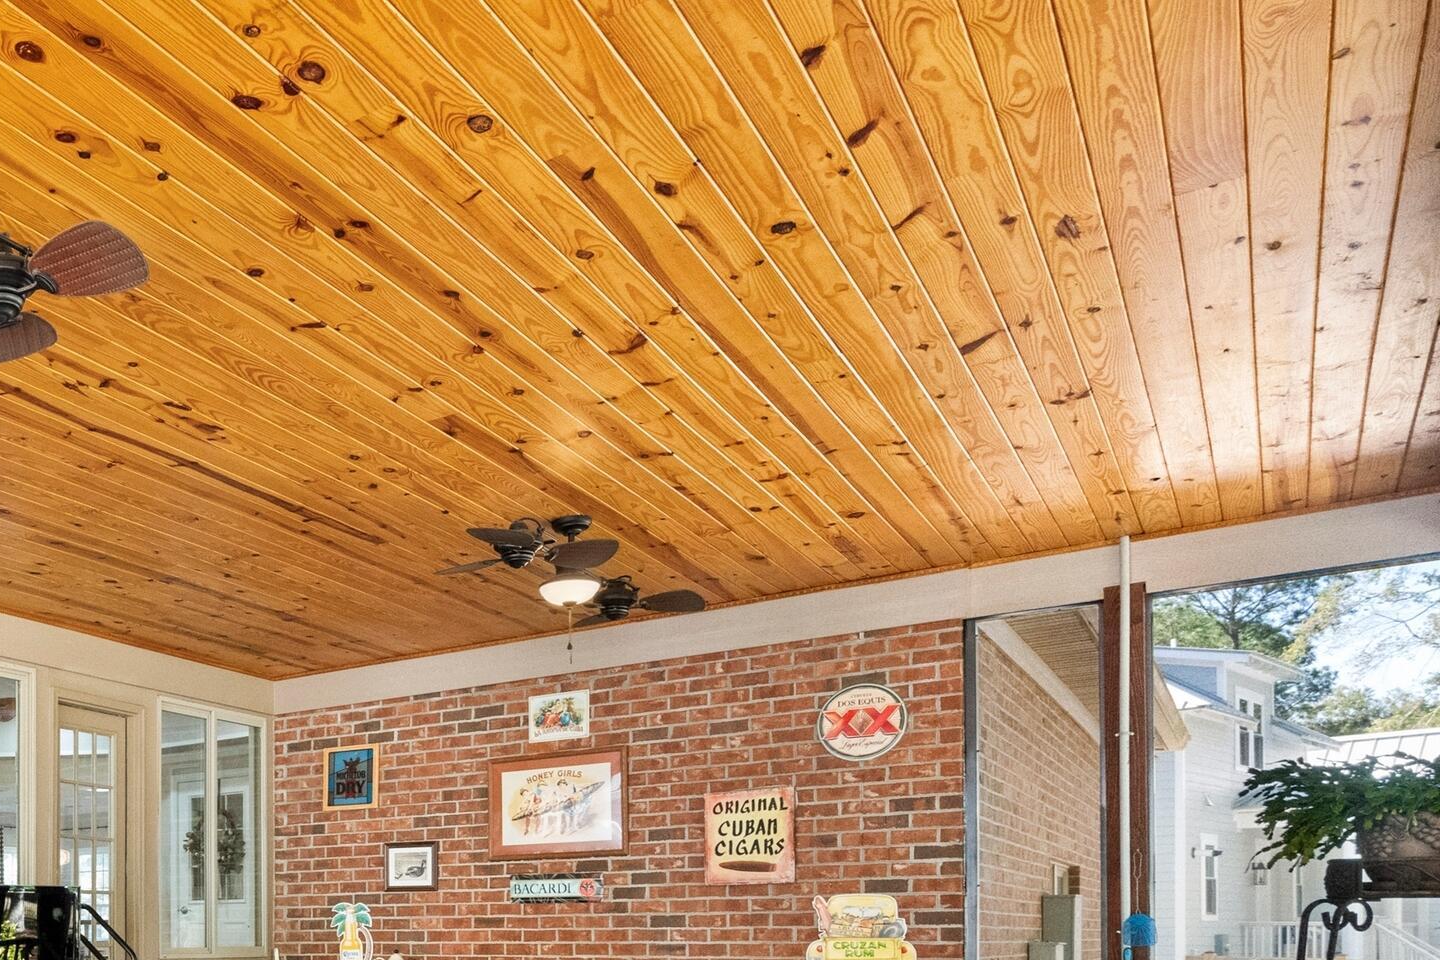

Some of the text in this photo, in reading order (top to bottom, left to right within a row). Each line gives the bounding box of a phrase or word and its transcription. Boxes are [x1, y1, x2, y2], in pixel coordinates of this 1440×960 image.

[837, 697, 886, 708] DOS EQUIS
[823, 704, 901, 740] XX
[526, 769, 583, 784] HONEY GIRLS
[336, 780, 366, 795] DRY
[712, 797, 789, 815] ORIGINAL
[718, 818, 778, 837] CUBAN
[714, 838, 785, 856] CIGARS
[513, 882, 571, 895] BACARDI
[832, 941, 887, 950] CRUZAN
[845, 949, 875, 958] RUM
